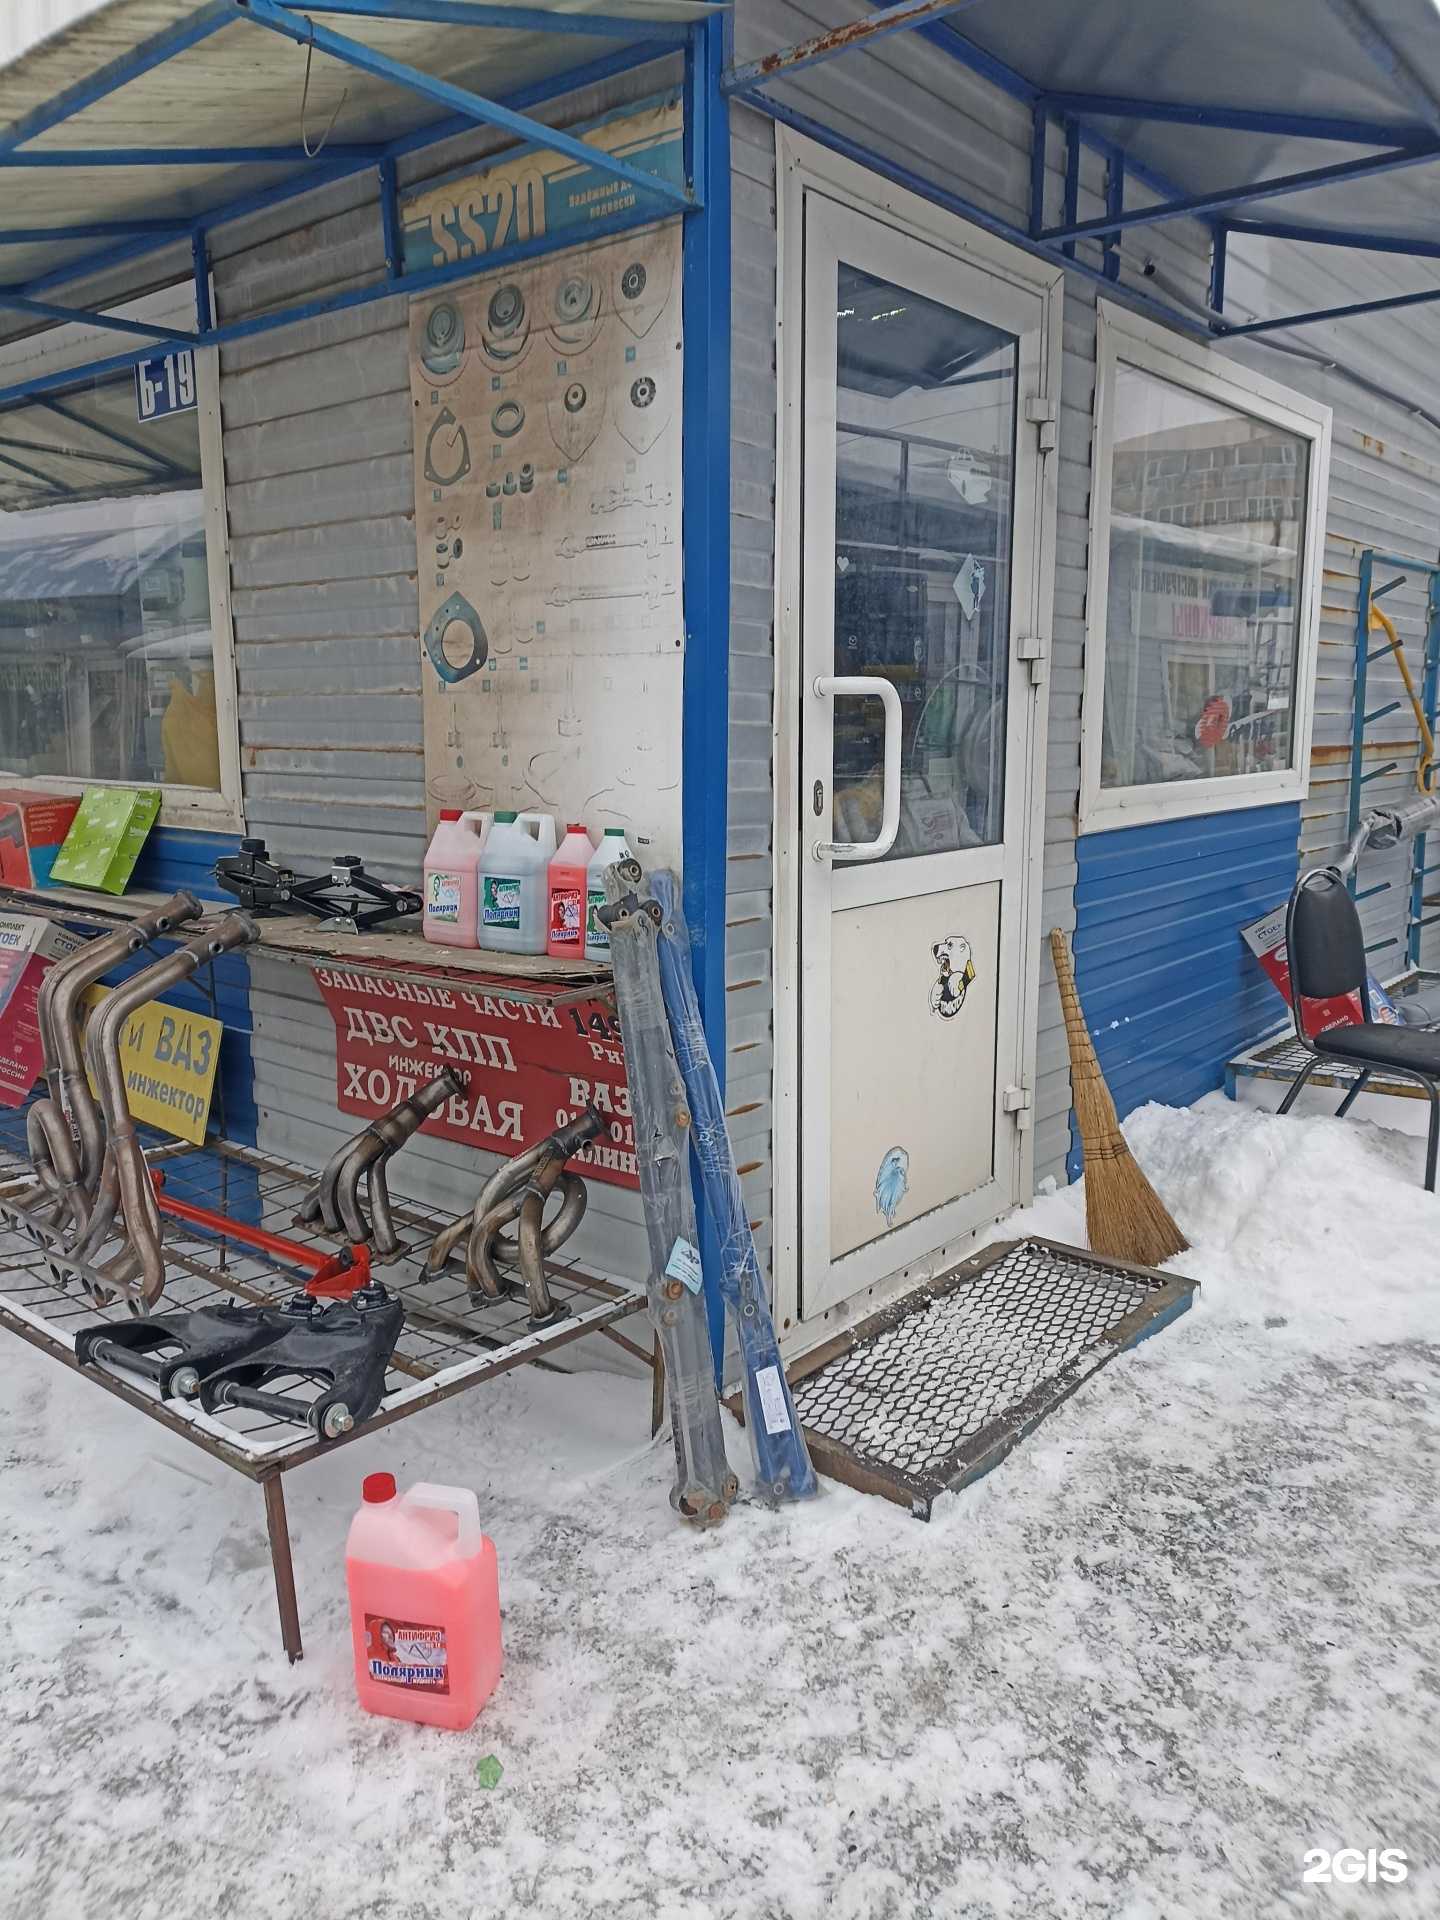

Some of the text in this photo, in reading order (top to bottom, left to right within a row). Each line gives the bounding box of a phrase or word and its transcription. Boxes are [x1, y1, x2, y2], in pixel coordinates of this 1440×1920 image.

[431, 168, 546, 267] SS20
[138, 350, 195, 416] Б-19
[315, 967, 562, 1028] ЗАПАСНЫЕ ЧАСТИ
[154, 1016, 212, 1077] ВАЗ
[343, 1006, 518, 1072] ДВС КПП
[127, 1070, 205, 1125] инжектор
[388, 1055, 472, 1086] ИНЖЕКОР
[569, 1077, 633, 1117] ВАЗ
[397, 1630, 441, 1641] АНТИФРИЗ
[372, 1660, 444, 1683] Полярник
